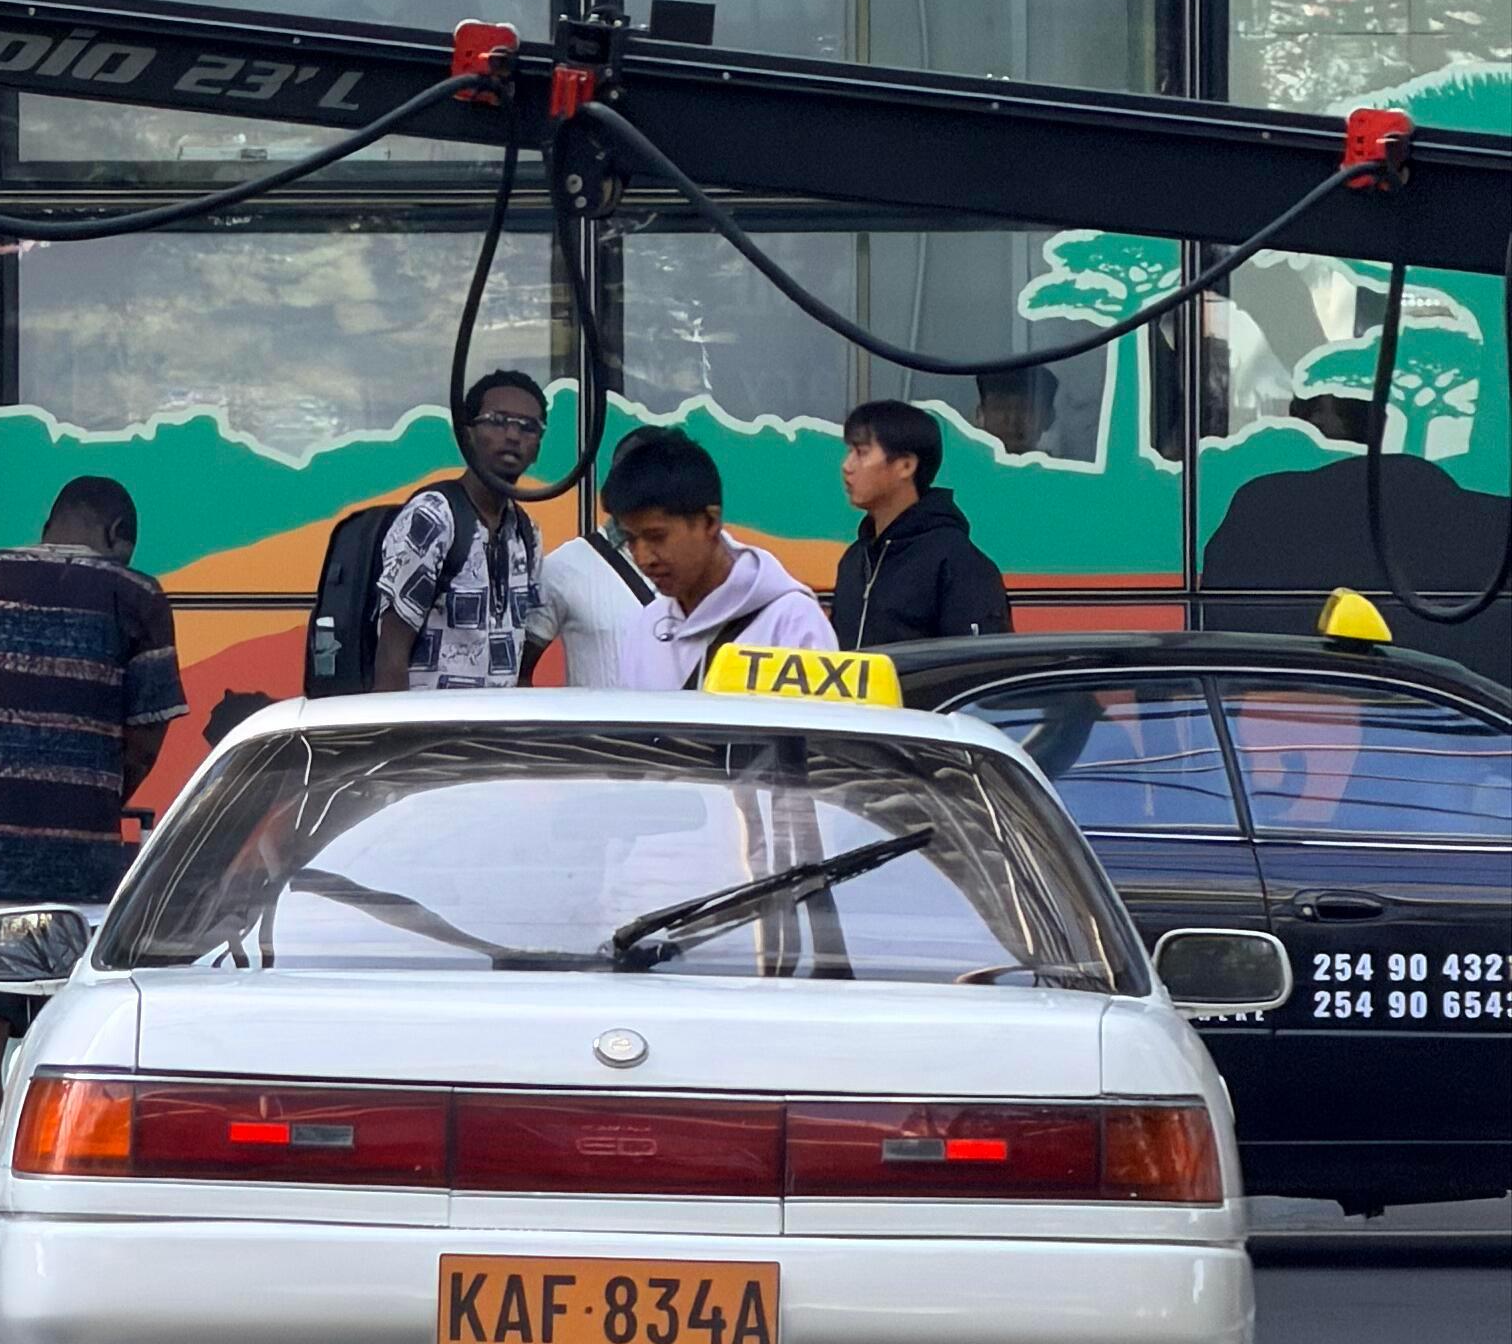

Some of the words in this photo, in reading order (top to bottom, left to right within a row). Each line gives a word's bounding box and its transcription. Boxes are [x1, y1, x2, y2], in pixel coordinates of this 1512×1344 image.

[318, 71, 364, 111] L
[738, 649, 871, 699] TAXI
[1313, 953, 1374, 981] 254
[1388, 953, 1428, 981] 90
[1313, 990, 1374, 1018] 254
[1388, 990, 1428, 1018] 90
